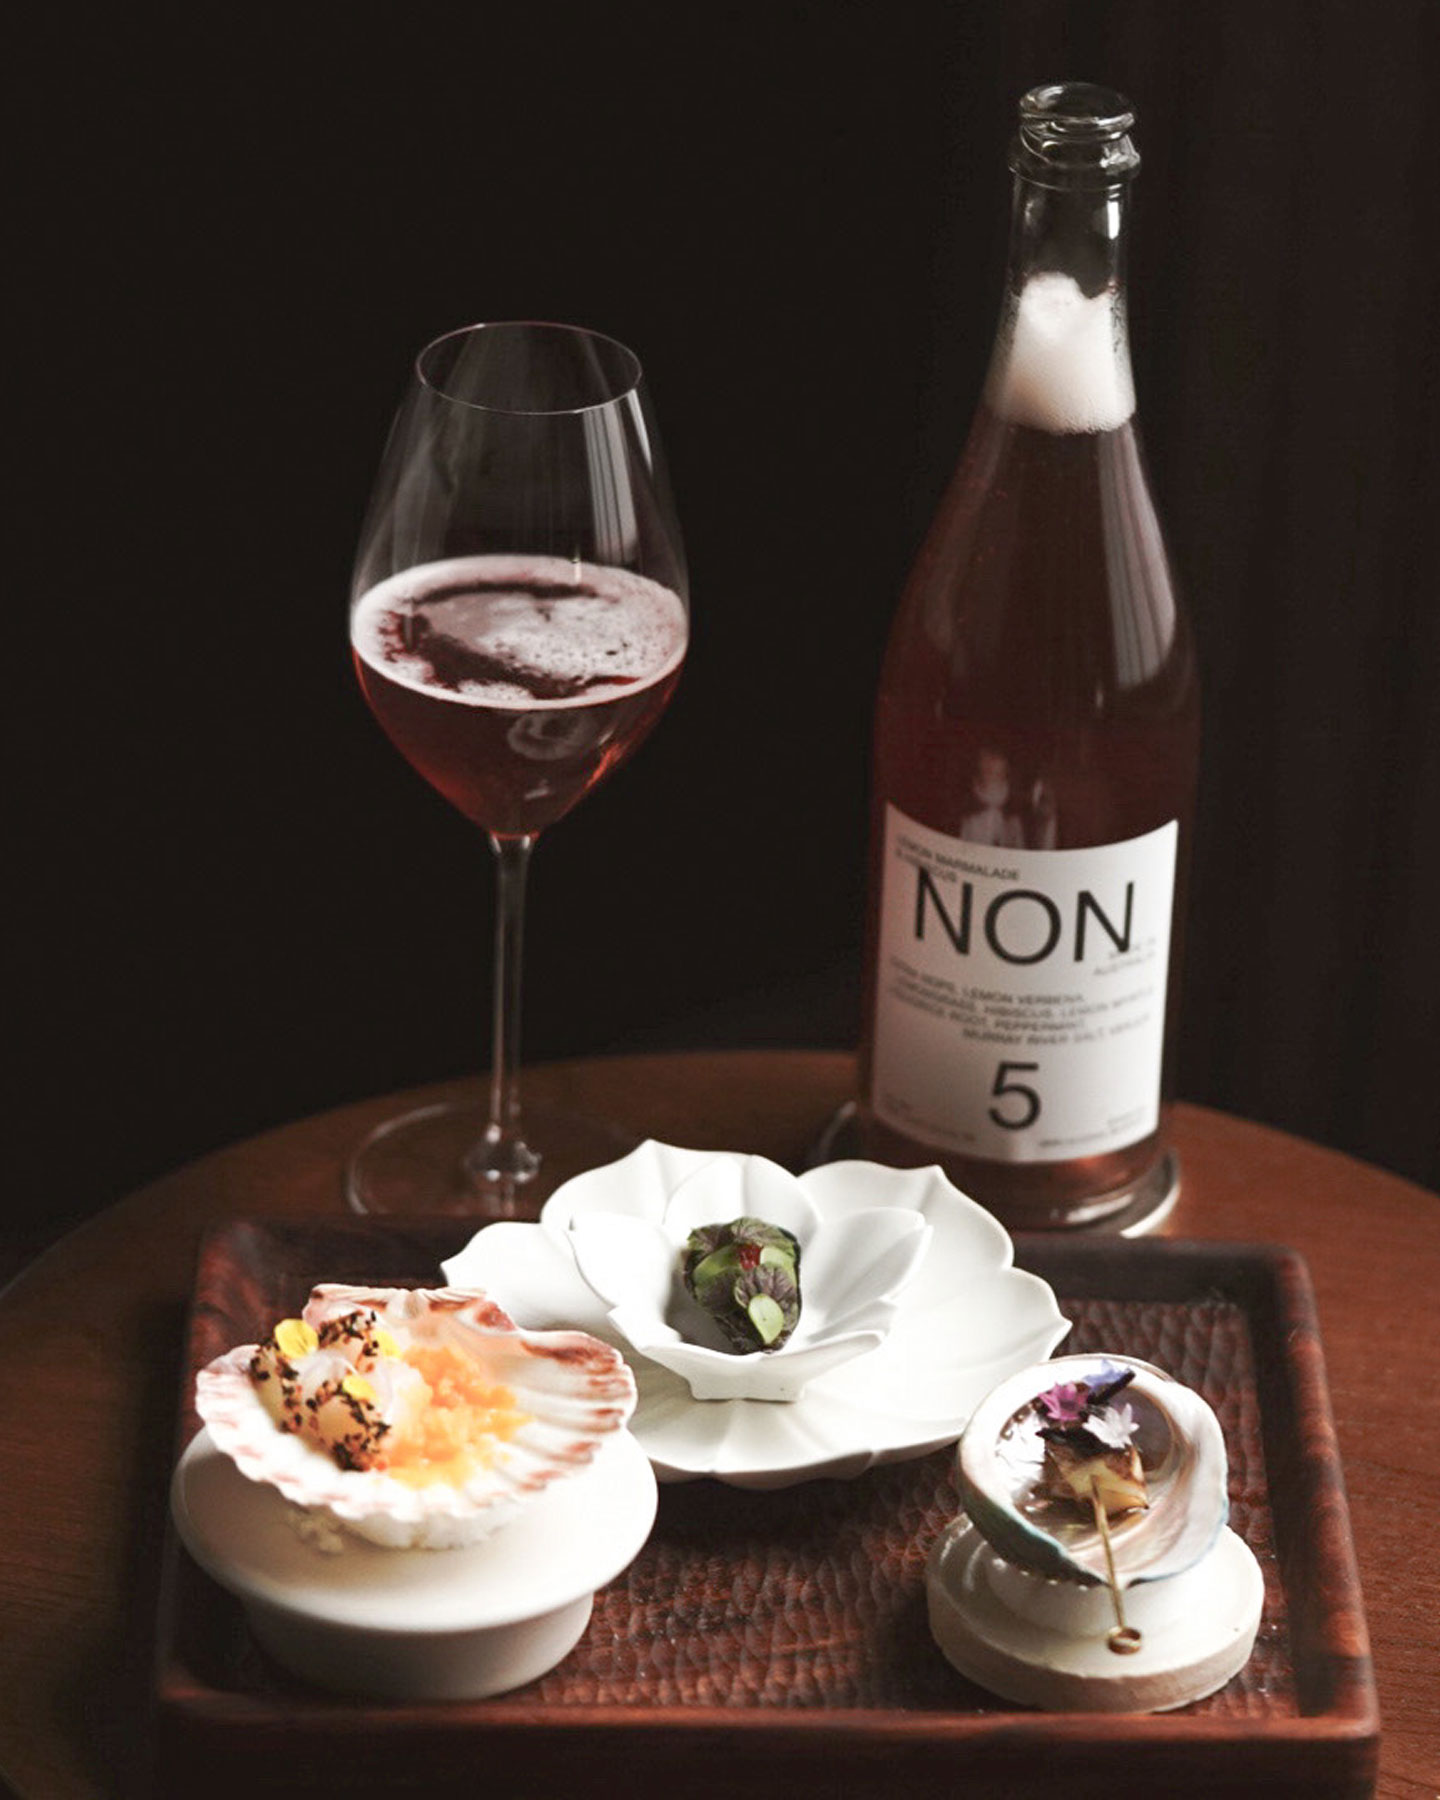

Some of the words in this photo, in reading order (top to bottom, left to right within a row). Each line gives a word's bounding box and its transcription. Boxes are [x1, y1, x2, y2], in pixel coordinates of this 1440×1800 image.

[935, 852, 1020, 881] MARMALADE
[913, 864, 1135, 966] NON
[962, 986, 1013, 1004] LEMON
[987, 1060, 1042, 1131] 5
